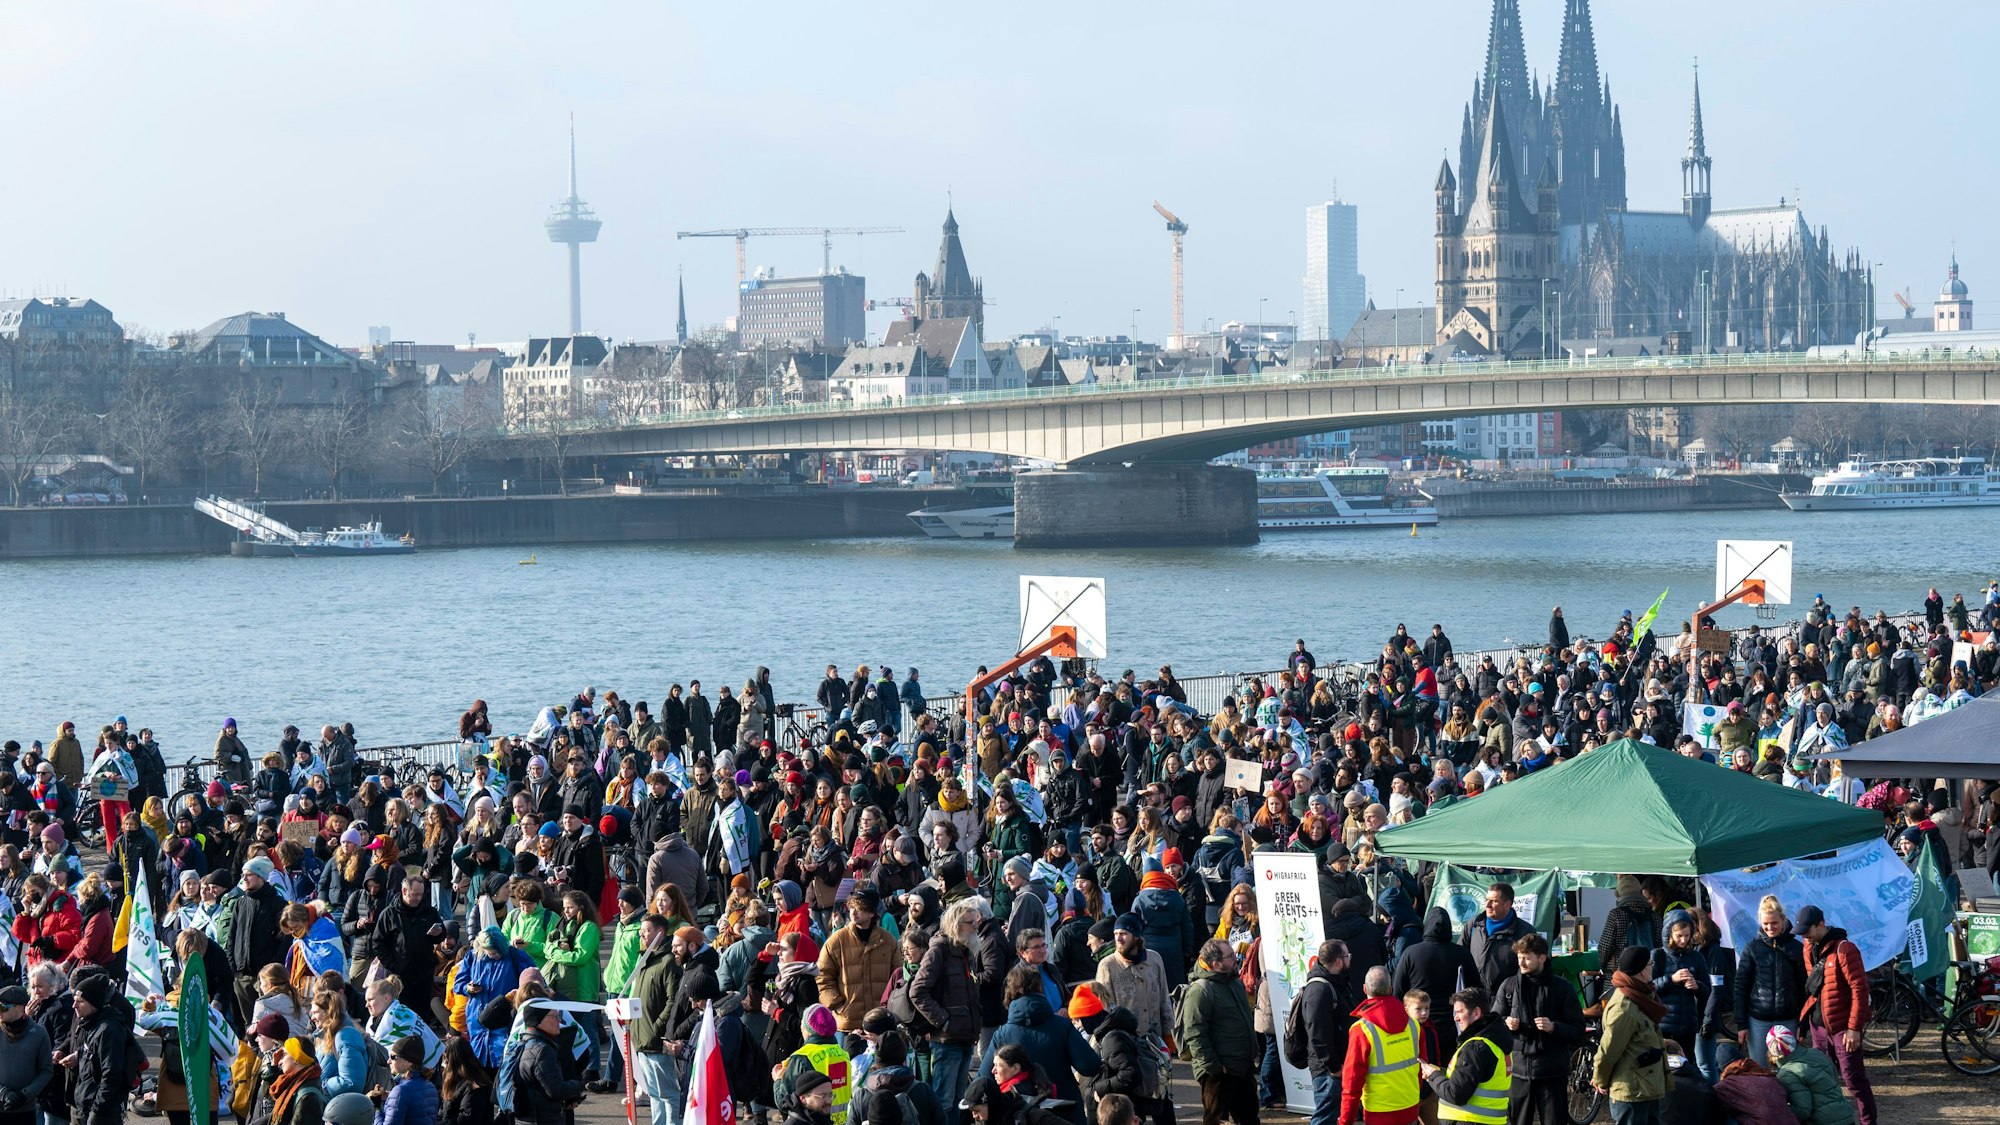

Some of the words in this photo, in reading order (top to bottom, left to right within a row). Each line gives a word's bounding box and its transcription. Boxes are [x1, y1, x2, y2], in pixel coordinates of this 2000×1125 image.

[1274, 871, 1307, 880] MIGRAFRICA
[1274, 891, 1301, 903] GREEN
[1973, 916, 1998, 926] 03.03.
